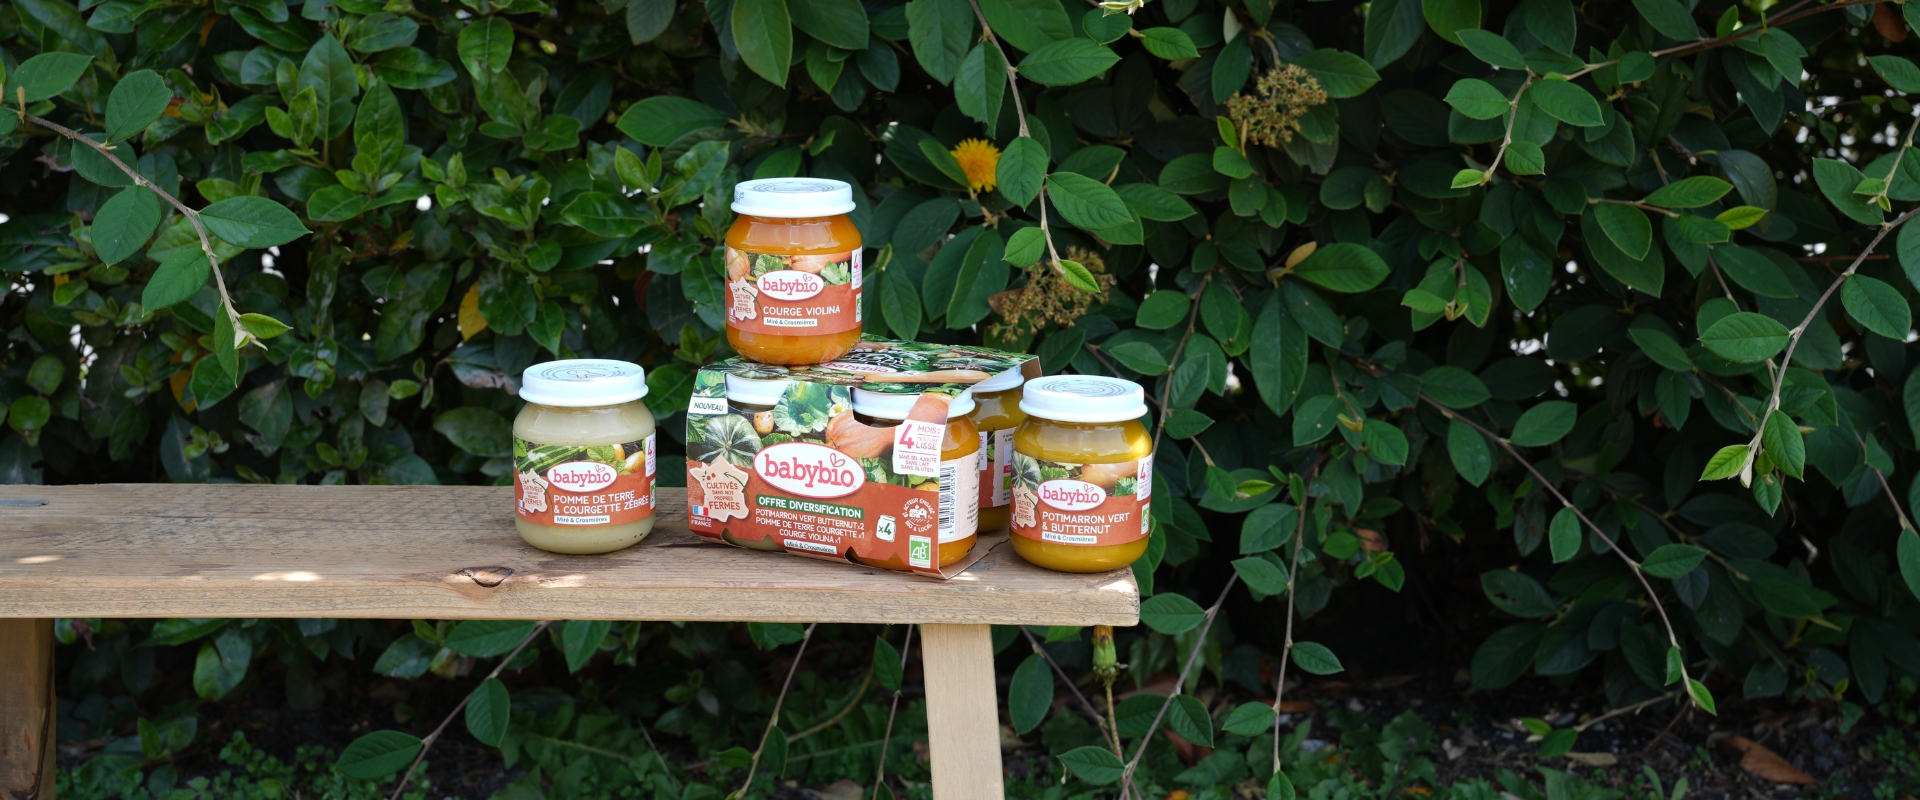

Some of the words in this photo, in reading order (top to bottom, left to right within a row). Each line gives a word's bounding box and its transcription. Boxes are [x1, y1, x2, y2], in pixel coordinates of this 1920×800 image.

[763, 276, 818, 295] babybio
[763, 306, 802, 316] COURGE
[806, 305, 840, 315] VIOLINA
[694, 402, 724, 411] NOUVEAU
[899, 424, 914, 449] 4
[916, 442, 937, 450] LISSE
[553, 468, 611, 487] babybio
[765, 454, 854, 488] babybio
[706, 482, 738, 490] CULTIVÉS
[554, 494, 589, 504] POMME
[593, 494, 606, 503] DE
[608, 490, 635, 502] TERRE
[1043, 484, 1099, 505] babybio
[525, 498, 542, 506] FERMES
[554, 505, 560, 514] &
[564, 503, 621, 514] COURGETTE
[624, 495, 649, 510] ZÉBRÉE
[709, 501, 740, 510] FERMES
[759, 497, 786, 508] OFFRE
[790, 500, 861, 518] DIVERSIFICATION
[904, 498, 918, 511] ACTEUR
[756, 509, 798, 520] POTIMARRON
[799, 514, 816, 523] VERT
[1042, 511, 1104, 524] POTIMARRON
[1108, 512, 1129, 522] VERT
[756, 517, 780, 527] POMME
[793, 522, 815, 532] TERRE
[817, 526, 857, 538] COURGETTE
[878, 523, 892, 535] x4
[1042, 522, 1048, 530] &
[1052, 524, 1110, 534] BUTTERNUT
[780, 529, 806, 539] COURGE
[808, 532, 835, 543] VIOLINA
[912, 546, 927, 559] AB
